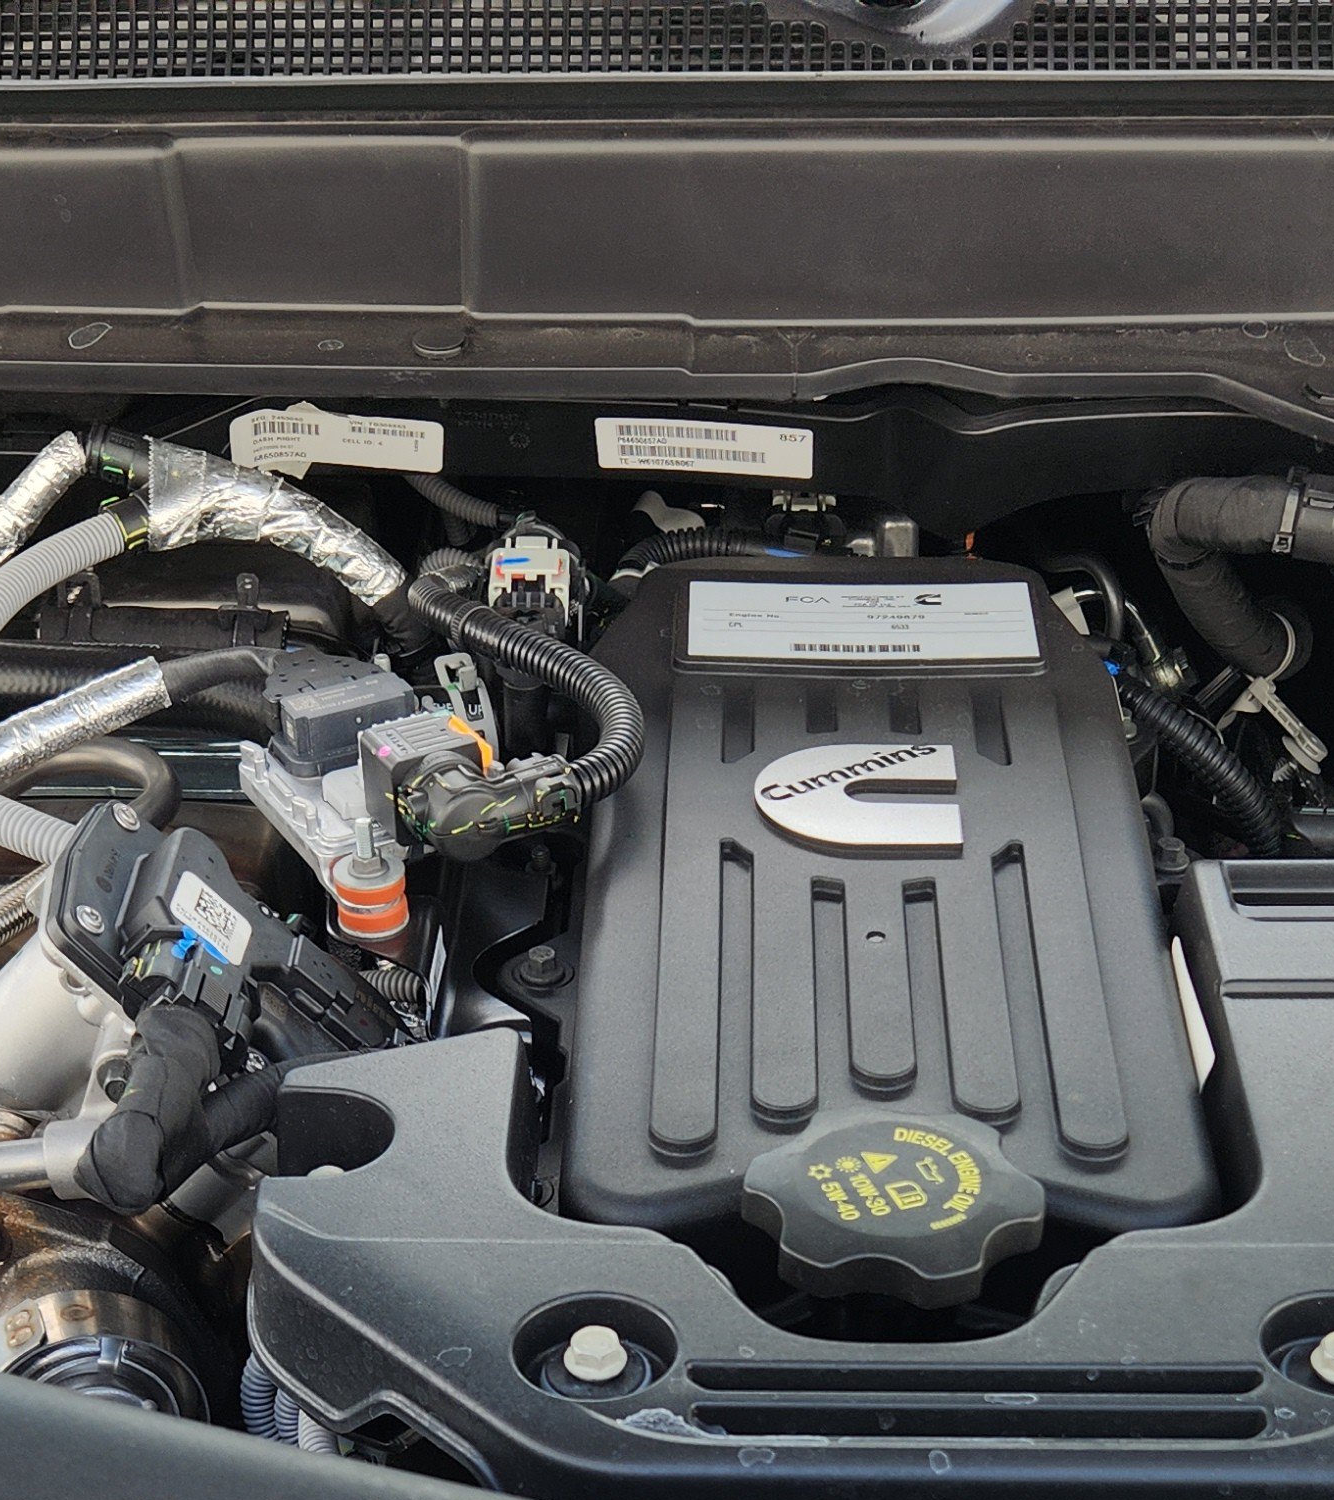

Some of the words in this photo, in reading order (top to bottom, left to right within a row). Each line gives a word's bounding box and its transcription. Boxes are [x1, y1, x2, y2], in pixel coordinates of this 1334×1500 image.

[779, 433, 807, 443] 857
[759, 744, 938, 801] Cummins
[893, 1126, 955, 1157] DIESEL
[946, 1149, 983, 1196] ENGINE
[820, 1180, 861, 1221] 5W-40
[849, 1172, 892, 1217] 10W-30
[942, 1191, 976, 1213] OIL
